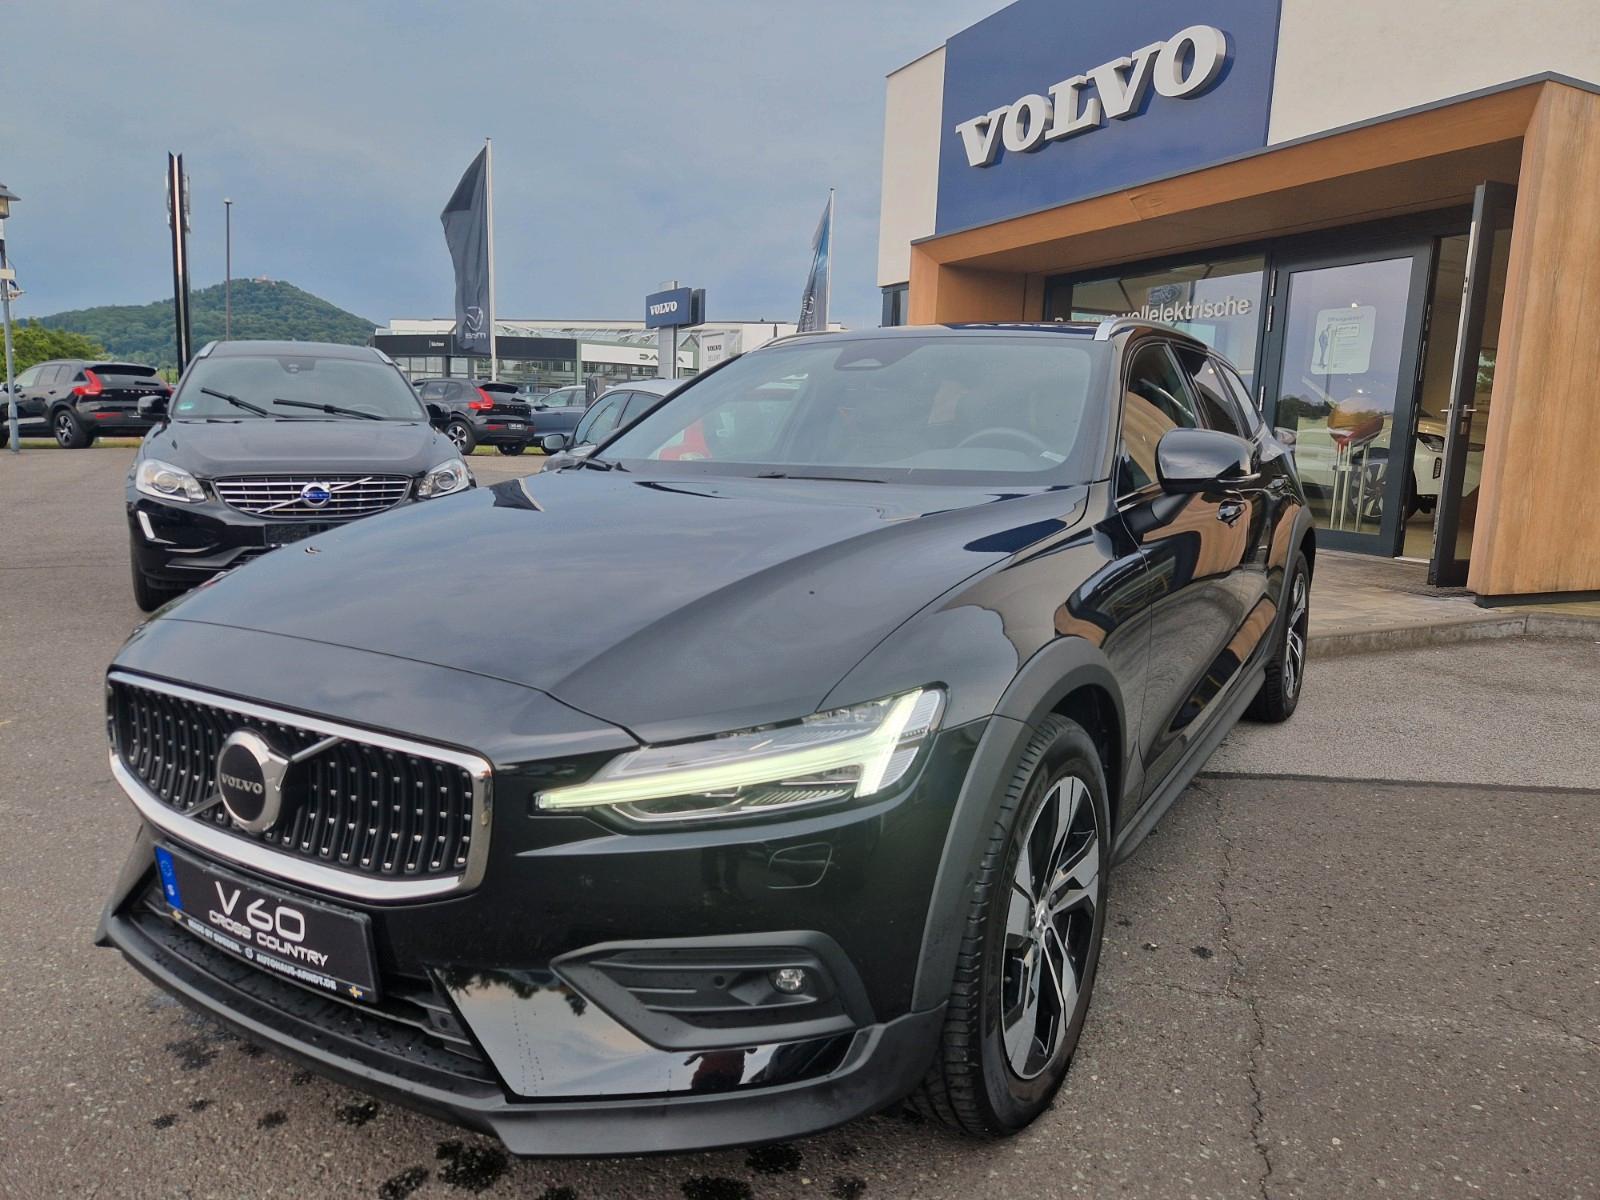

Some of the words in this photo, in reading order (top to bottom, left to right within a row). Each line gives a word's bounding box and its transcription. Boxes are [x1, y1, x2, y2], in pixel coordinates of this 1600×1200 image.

[955, 24, 1228, 169] VOLVO
[650, 301, 678, 316] VOLVO
[220, 772, 264, 795] VOLVO
[208, 909, 253, 940] CROSS
[256, 931, 329, 967] COUNTRY
[214, 880, 241, 916] V
[246, 898, 306, 943] 60
